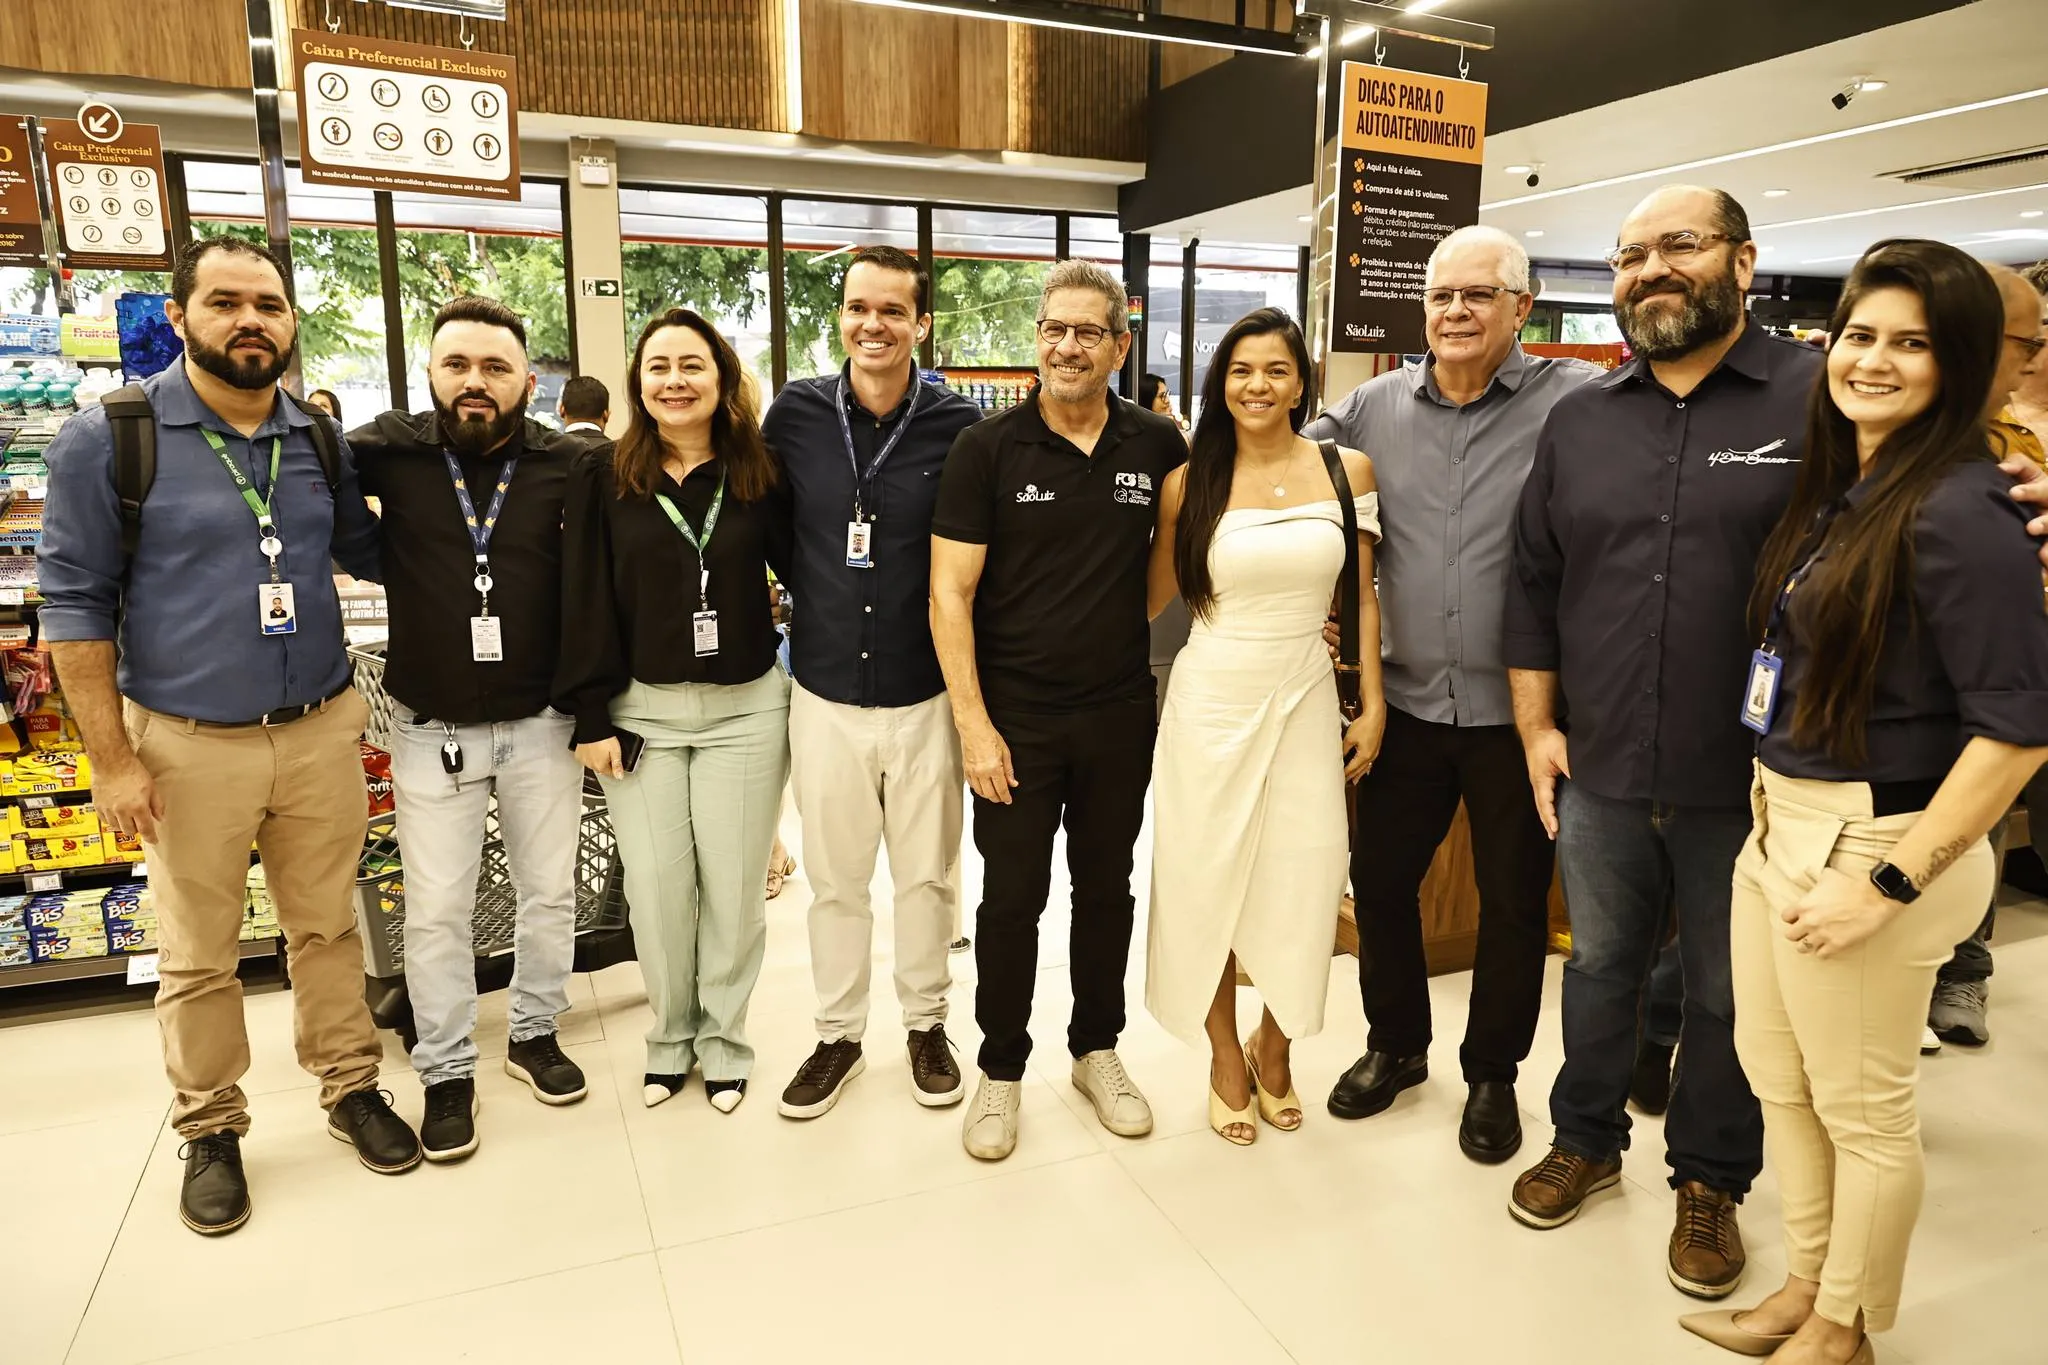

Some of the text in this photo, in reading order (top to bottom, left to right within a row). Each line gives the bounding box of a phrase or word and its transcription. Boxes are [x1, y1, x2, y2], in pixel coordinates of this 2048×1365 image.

[302, 41, 507, 79] Caixa Preferencial Exclusivo
[1358, 77, 1444, 114] DICAS PARA O
[1356, 110, 1476, 149] AUTOATENDIMENTO
[53, 141, 153, 157] Caixa Preferencial
[79, 151, 131, 163] Exclusivo
[1366, 162, 1381, 173] Aqui
[1388, 164, 1398, 174] fila
[1399, 165, 1403, 174] é
[1404, 166, 1423, 177] única.
[311, 169, 321, 177] Na
[322, 171, 350, 180] ausência
[394, 178, 424, 186] atendidos
[425, 180, 449, 188] clientes
[1365, 183, 1450, 201] Compras de até 15 volumes.
[1364, 205, 1435, 220] Formas de pagamento:
[1363, 215, 1384, 226] débito,
[1385, 218, 1407, 228] crédito
[1407, 220, 1420, 229] (não
[1363, 226, 1375, 236] PIX,
[1375, 228, 1399, 237] cartões
[1399, 229, 1408, 238] de
[1367, 237, 1393, 248] refeição.
[1361, 257, 1388, 267] Proibida
[1394, 261, 1413, 269] venda
[1413, 262, 1422, 270] de
[1360, 268, 1392, 278] alcoólicas
[1392, 271, 1407, 280] para
[1360, 278, 1368, 286] 18
[1368, 280, 1384, 288] anos
[1359, 288, 1398, 300] alimentação
[350, 609, 374, 619] OUTRO
